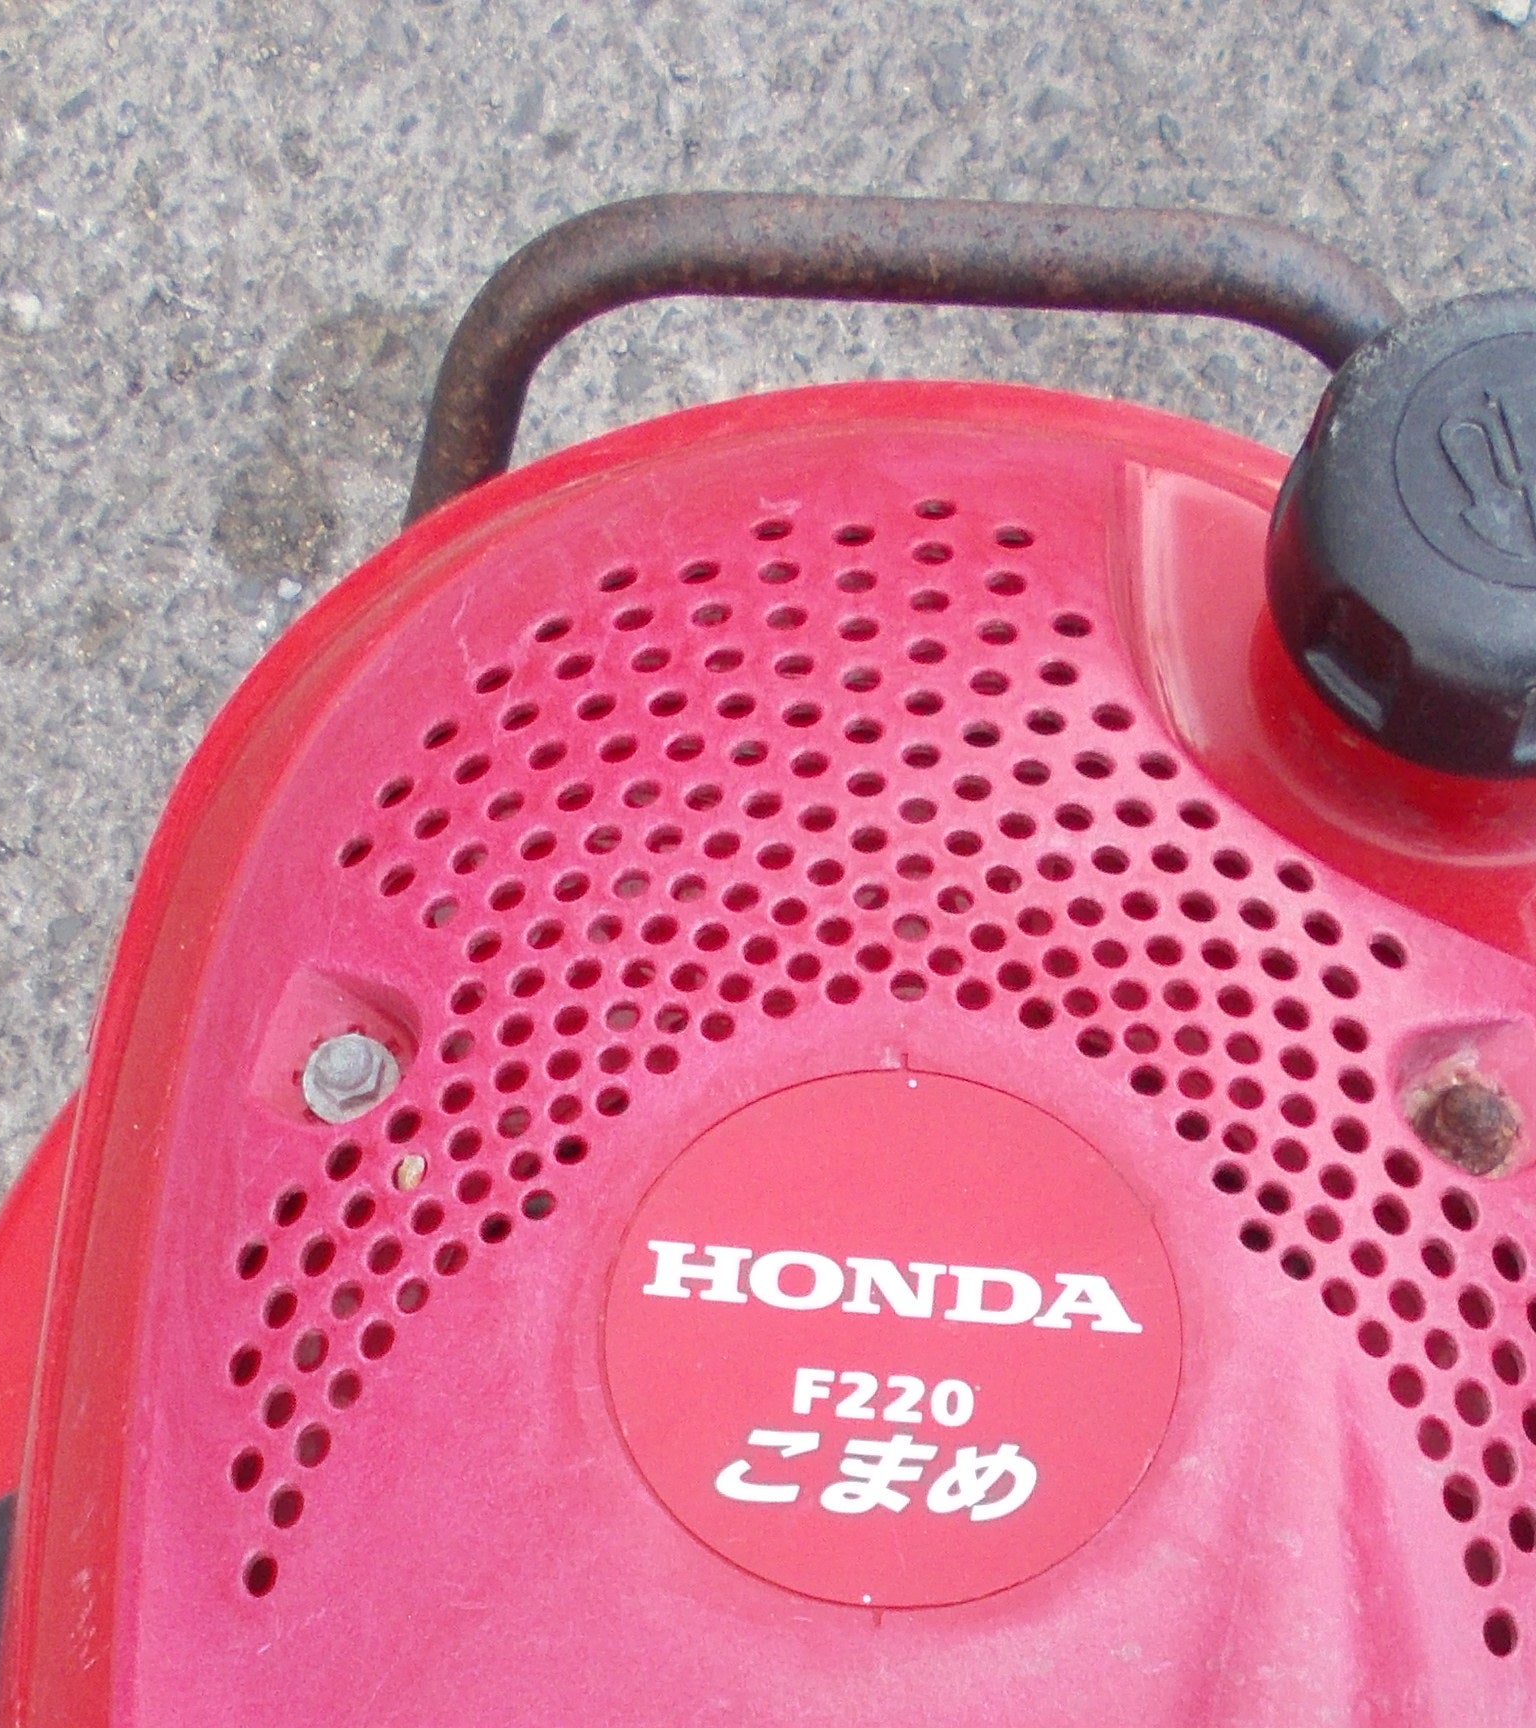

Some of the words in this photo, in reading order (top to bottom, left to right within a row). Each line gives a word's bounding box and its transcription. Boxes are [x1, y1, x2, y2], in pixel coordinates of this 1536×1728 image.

[643, 1240, 1143, 1334] HONDA
[792, 1367, 975, 1427] F220
[714, 1429, 1038, 1522] こまめ
